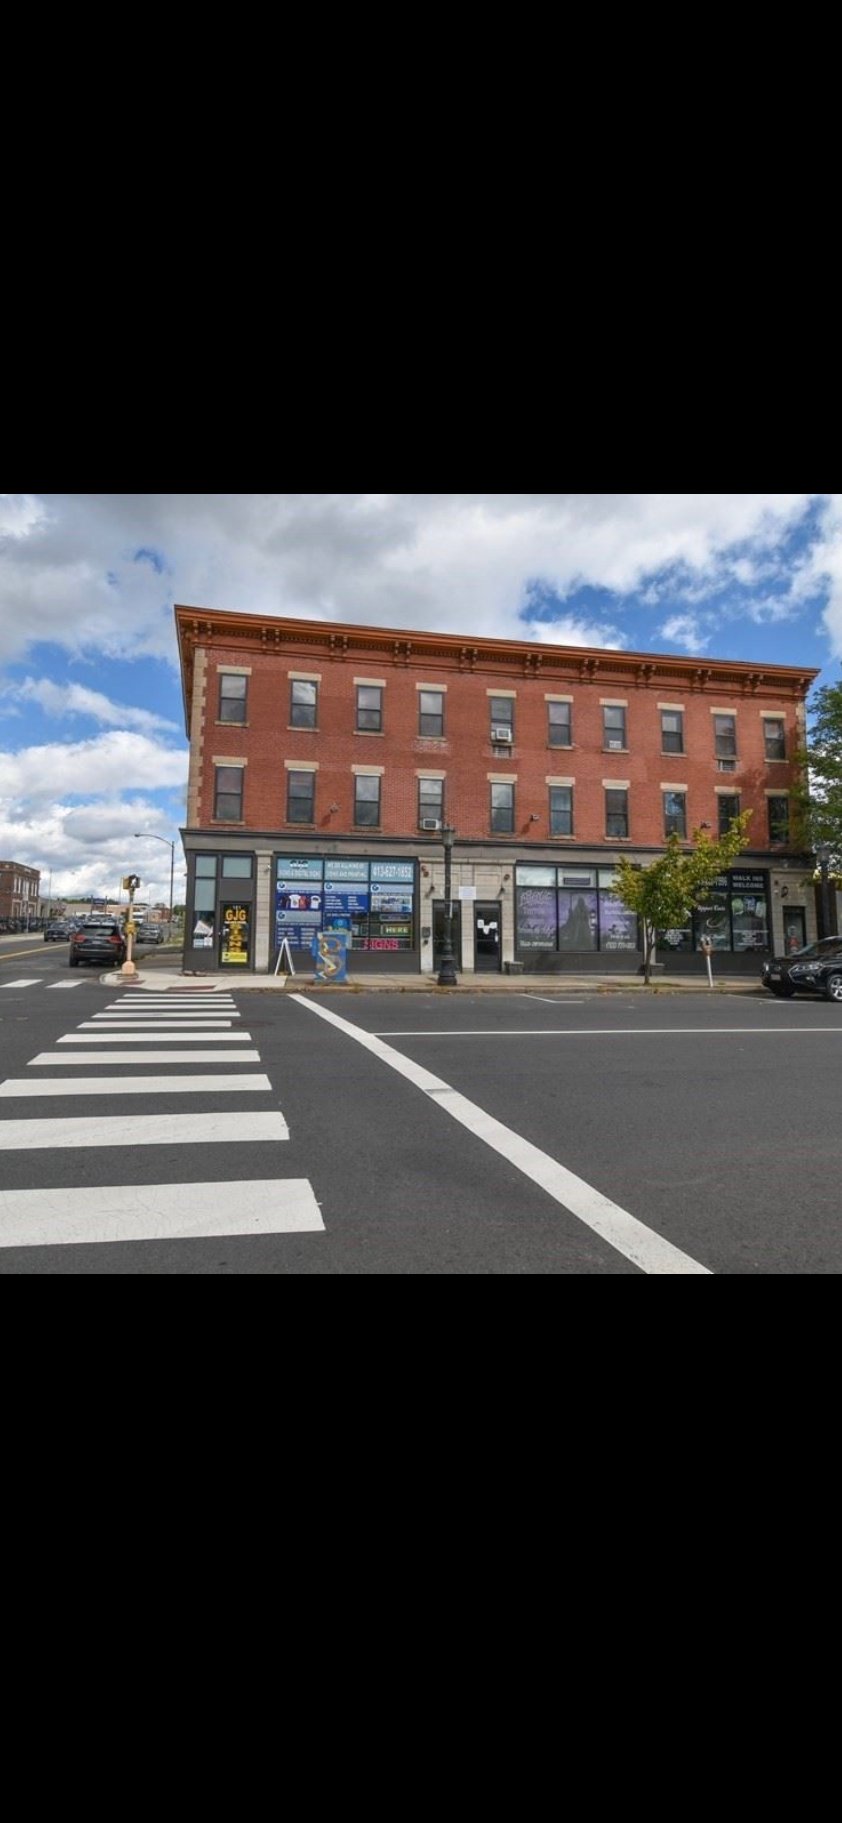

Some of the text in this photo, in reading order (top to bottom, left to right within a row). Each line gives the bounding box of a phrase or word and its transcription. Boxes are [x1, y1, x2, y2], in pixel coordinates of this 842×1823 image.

[226, 910, 246, 921] GJG
[386, 926, 409, 934] HERE
[362, 938, 399, 950] SIGNS
